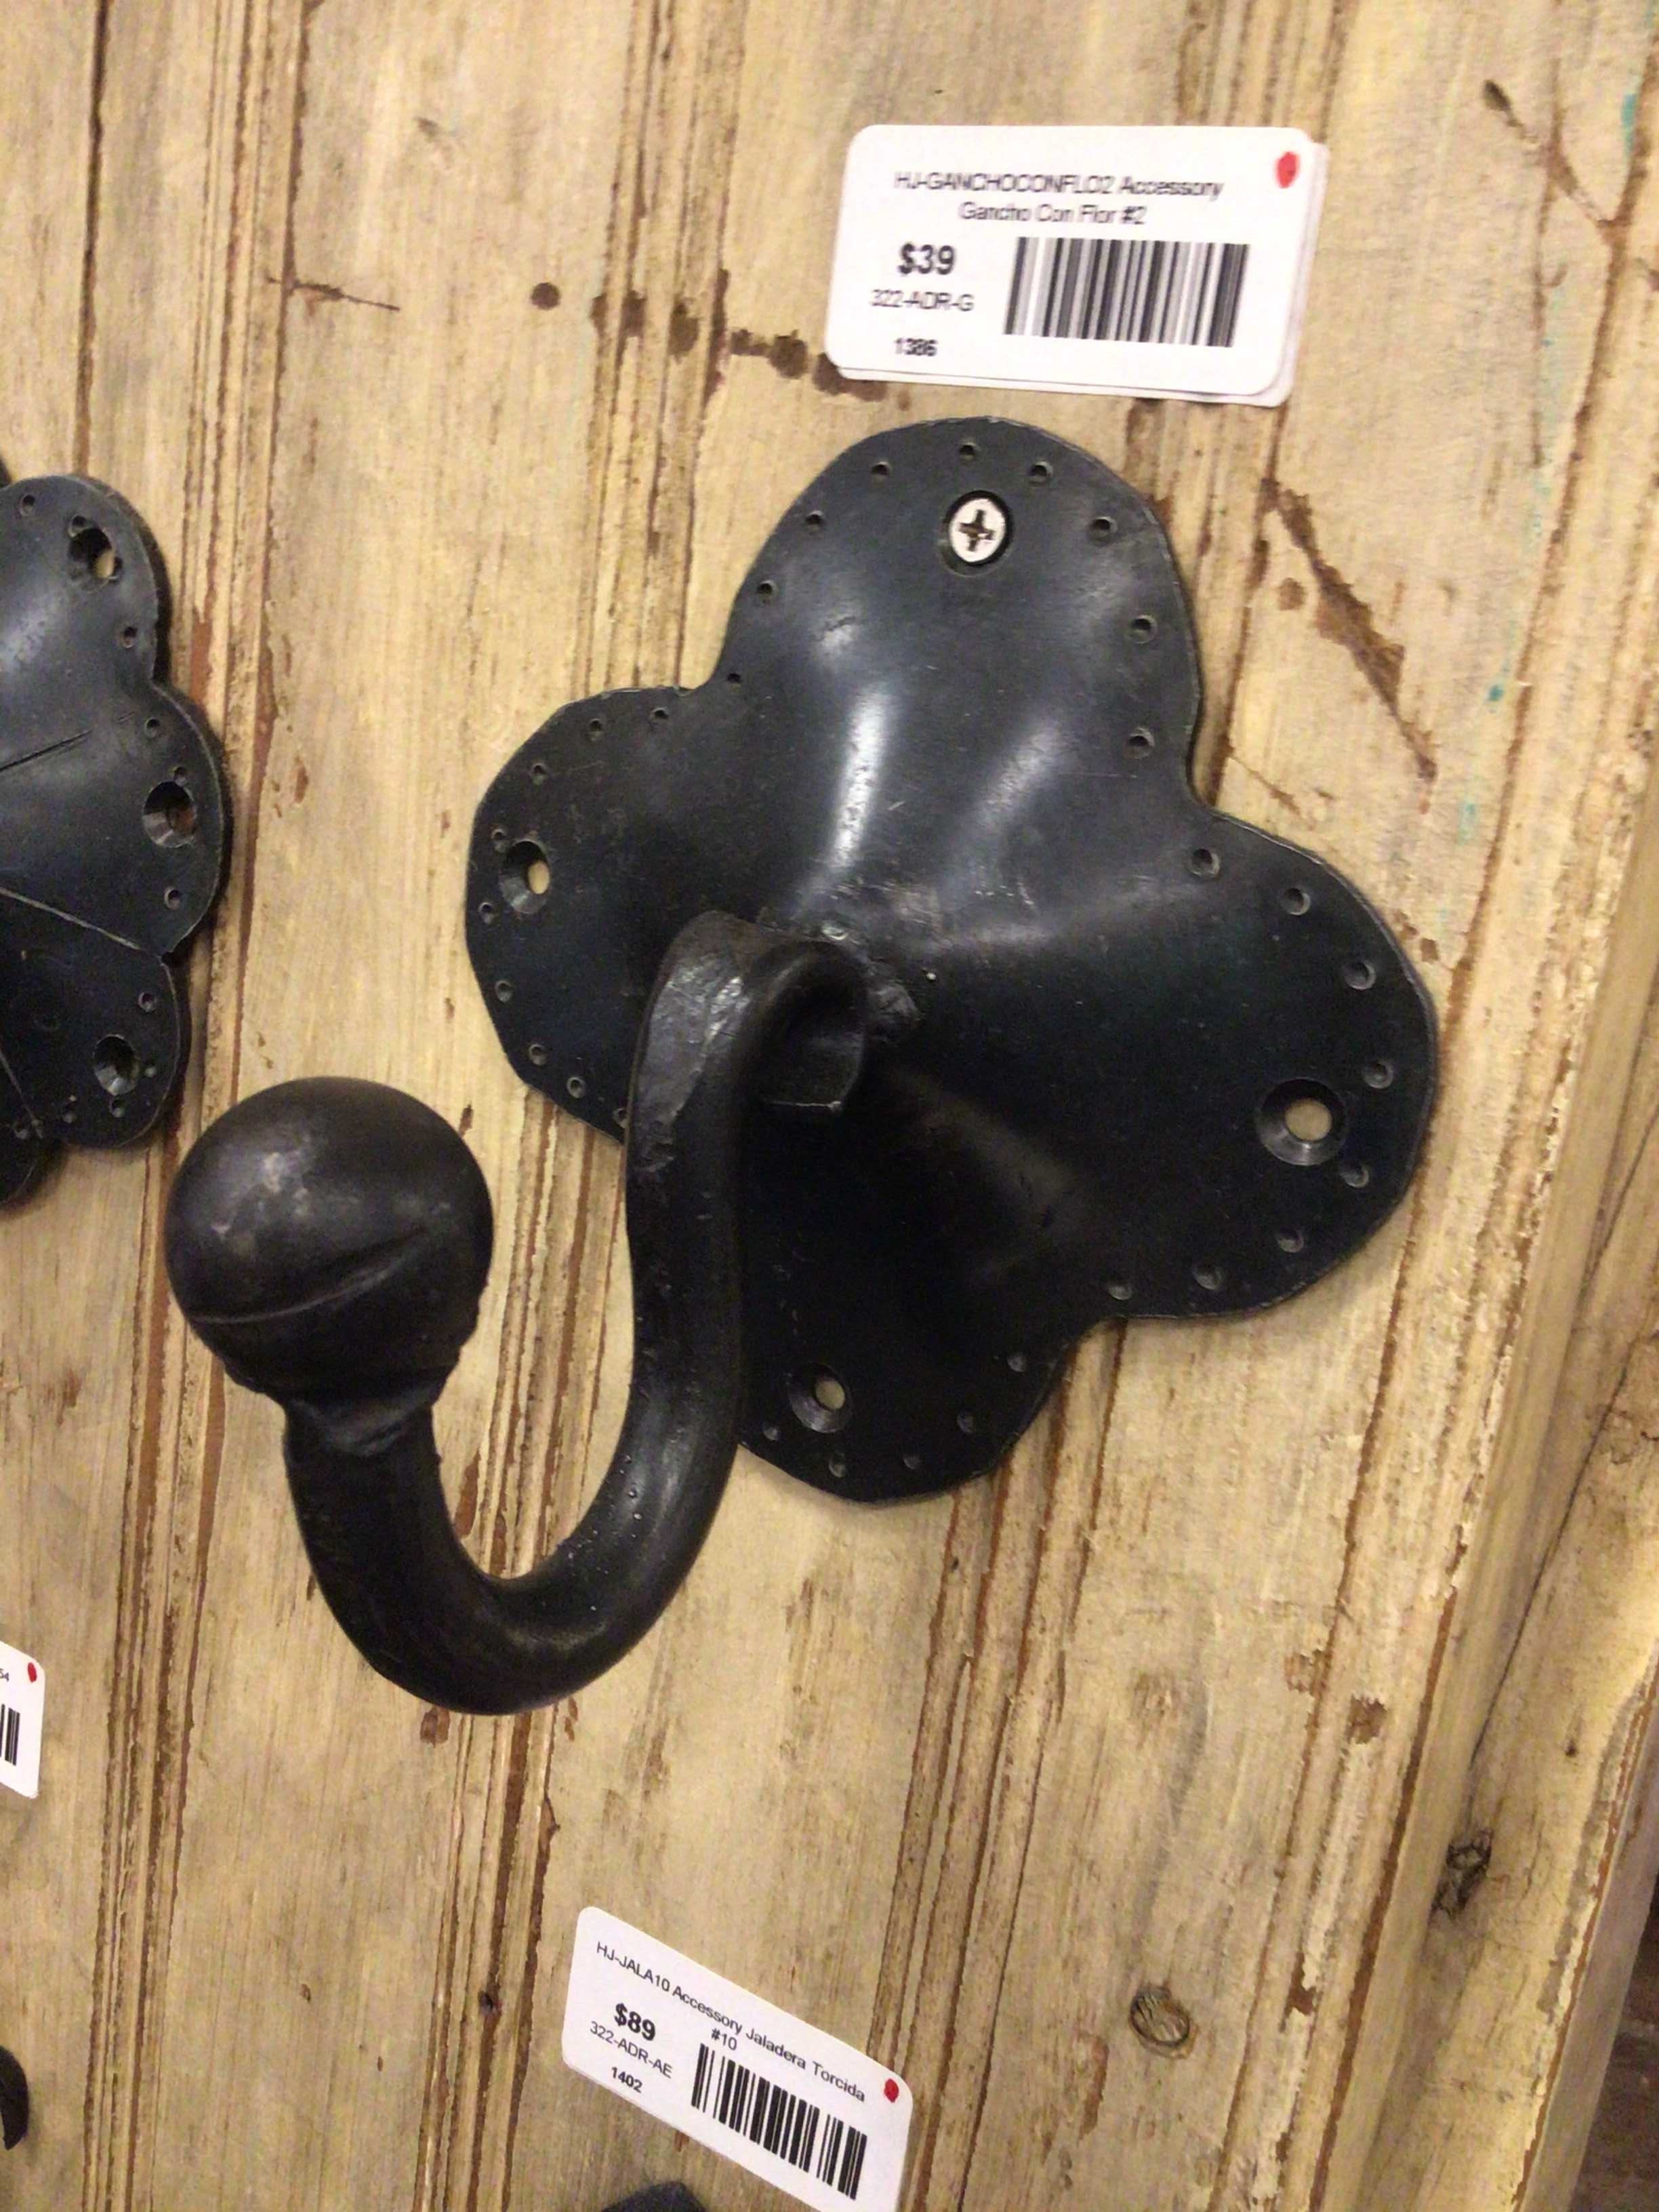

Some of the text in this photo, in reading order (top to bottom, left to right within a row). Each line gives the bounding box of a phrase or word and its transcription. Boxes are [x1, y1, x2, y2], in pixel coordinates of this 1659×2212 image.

[1119, 174, 1224, 203] Accessory
[957, 201, 1148, 225] Gancho Con Flor #2
[898, 241, 956, 276] $39
[869, 288, 976, 312] 322-ADR-G
[596, 1941, 866, 2102] HJ-JALA10 Accessory Jaladera Torcida
[613, 2002, 656, 2042] $89
[589, 2020, 674, 2079] 322-ADR-AE
[710, 2028, 738, 2051] #10
[611, 2066, 644, 2094] 1402
